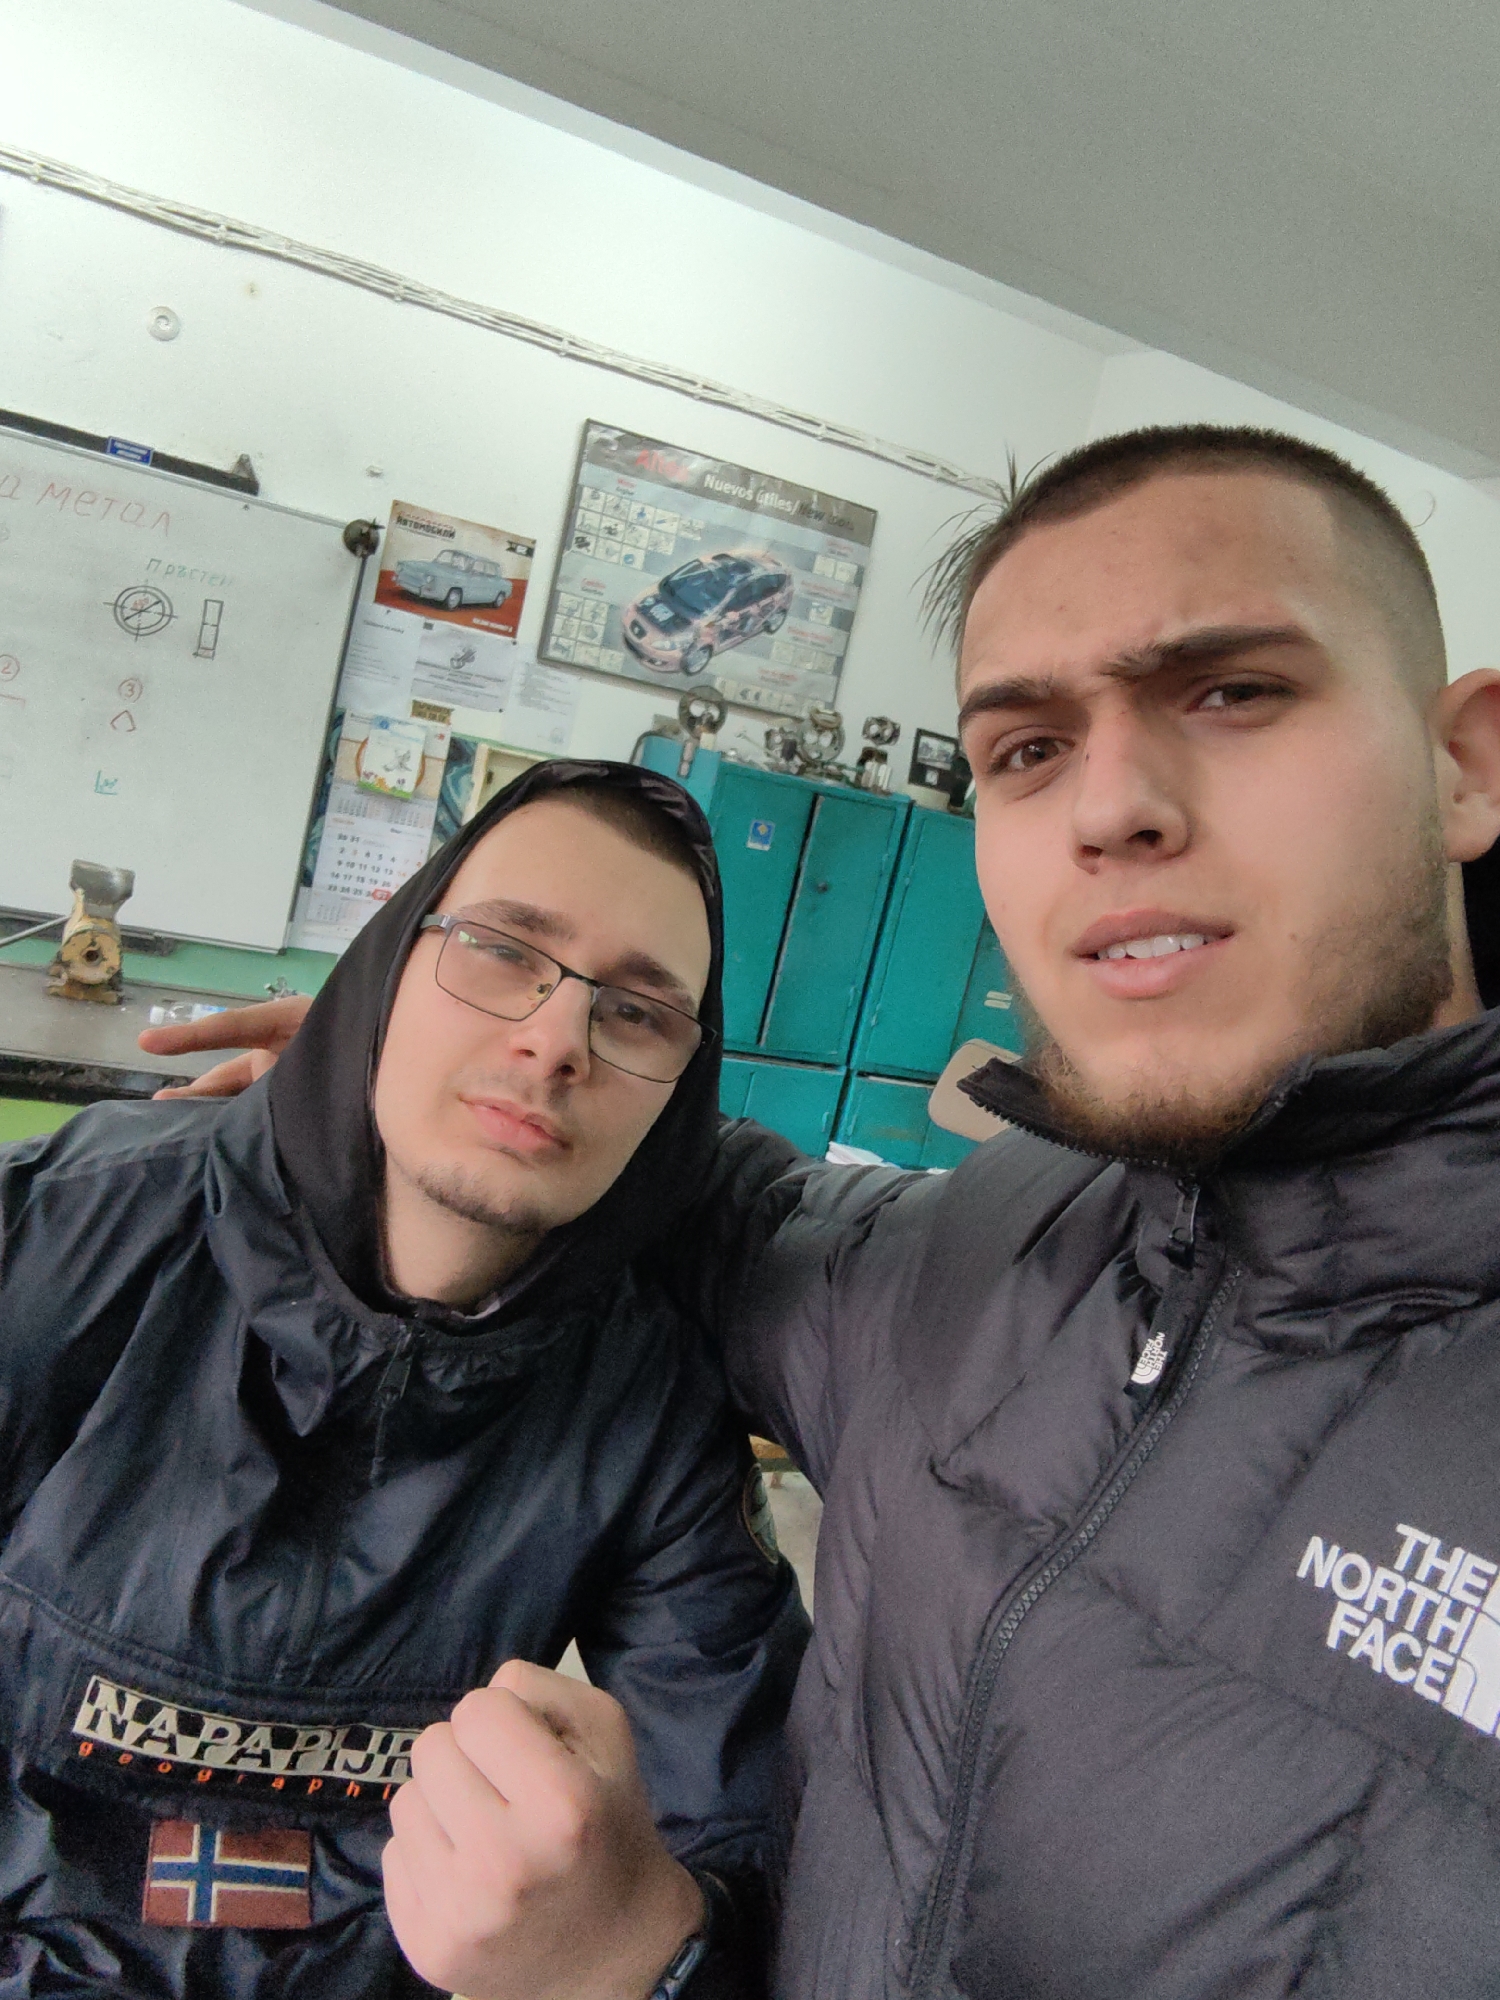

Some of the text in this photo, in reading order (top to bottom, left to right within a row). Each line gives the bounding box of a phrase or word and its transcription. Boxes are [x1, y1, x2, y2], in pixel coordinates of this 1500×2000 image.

[36, 482, 171, 537] метал
[703, 473, 754, 501] Nuevos
[1296, 1535, 1475, 1655] NORTH
[1393, 1522, 1499, 1608] THE
[1326, 1600, 1458, 1703] FACE
[78, 1740, 392, 1801] geographi
[82, 1678, 416, 1780] NAPAPIJR
